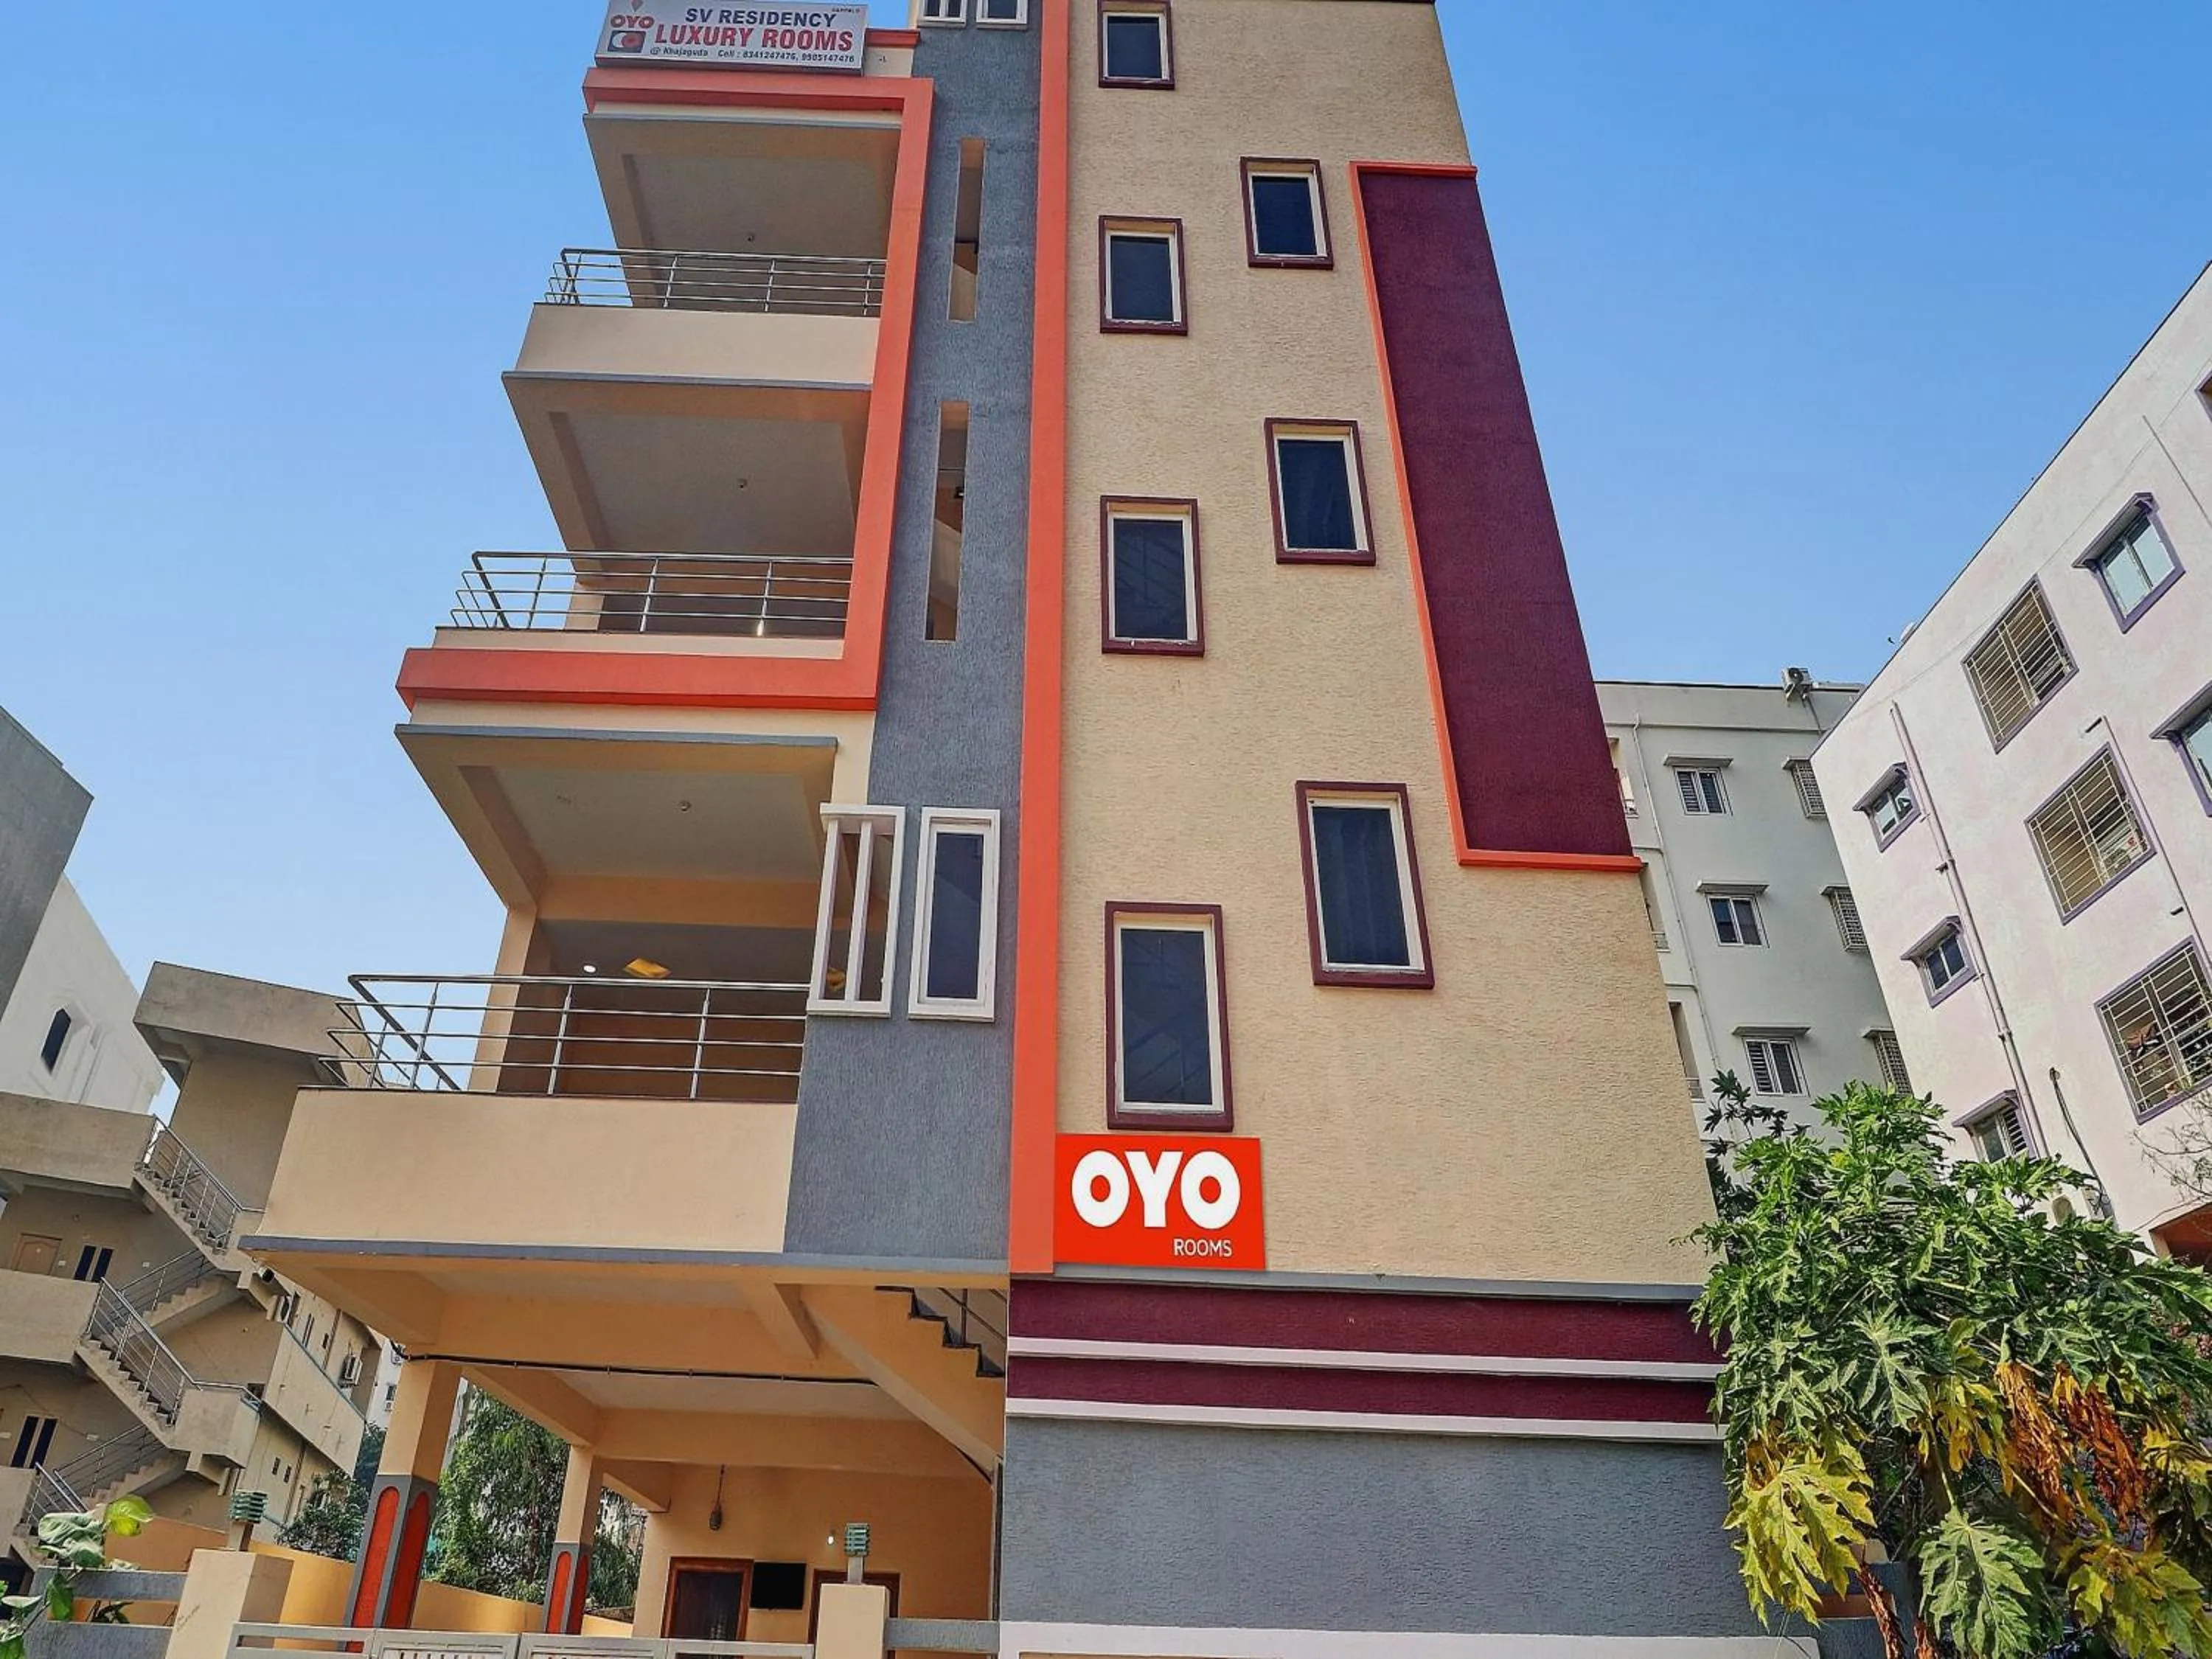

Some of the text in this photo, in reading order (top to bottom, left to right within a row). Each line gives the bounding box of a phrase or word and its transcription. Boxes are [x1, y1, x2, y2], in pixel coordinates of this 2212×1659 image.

[610, 14, 655, 29] OYO
[686, 8, 713, 23] SV
[718, 10, 837, 28] RESIDENCY
[654, 24, 853, 52] LUXURY ROOMS
[650, 46, 661, 55] @
[1071, 1150, 1241, 1230] OYO
[1173, 1238, 1233, 1257] ROOMS
